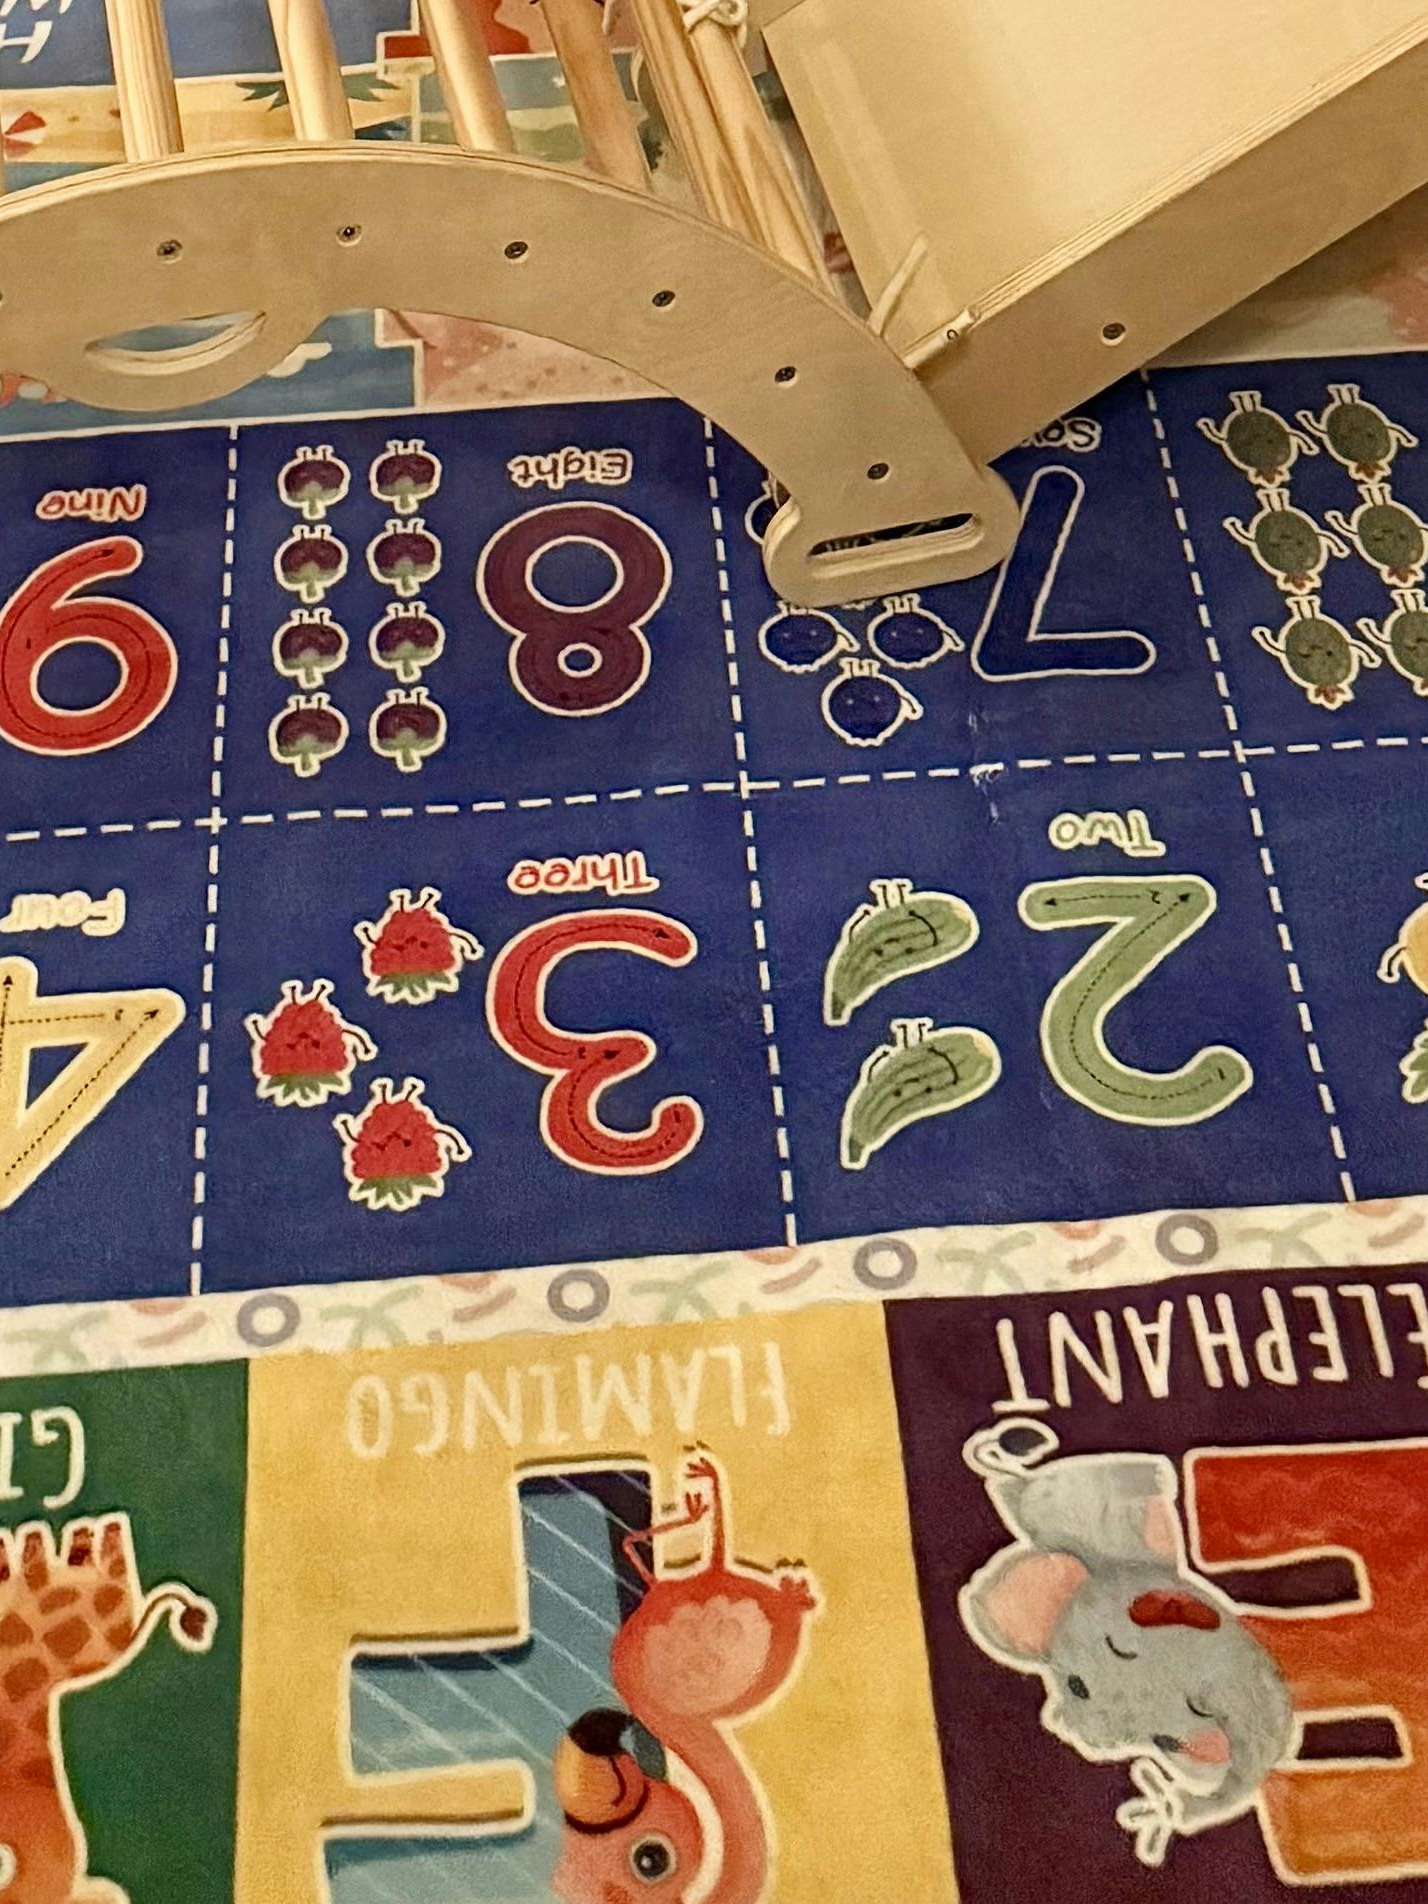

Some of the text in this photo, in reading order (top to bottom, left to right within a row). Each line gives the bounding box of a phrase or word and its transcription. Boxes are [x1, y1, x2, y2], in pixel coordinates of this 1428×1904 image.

[34, 482, 147, 523] Nine
[507, 447, 634, 489] Eight
[476, 500, 673, 719] 8
[507, 847, 659, 896] Three
[1048, 809, 1167, 857] Two
[485, 907, 705, 1177] 3
[1016, 874, 1255, 1128] 2
[343, 1342, 788, 1460] FLAMINGO
